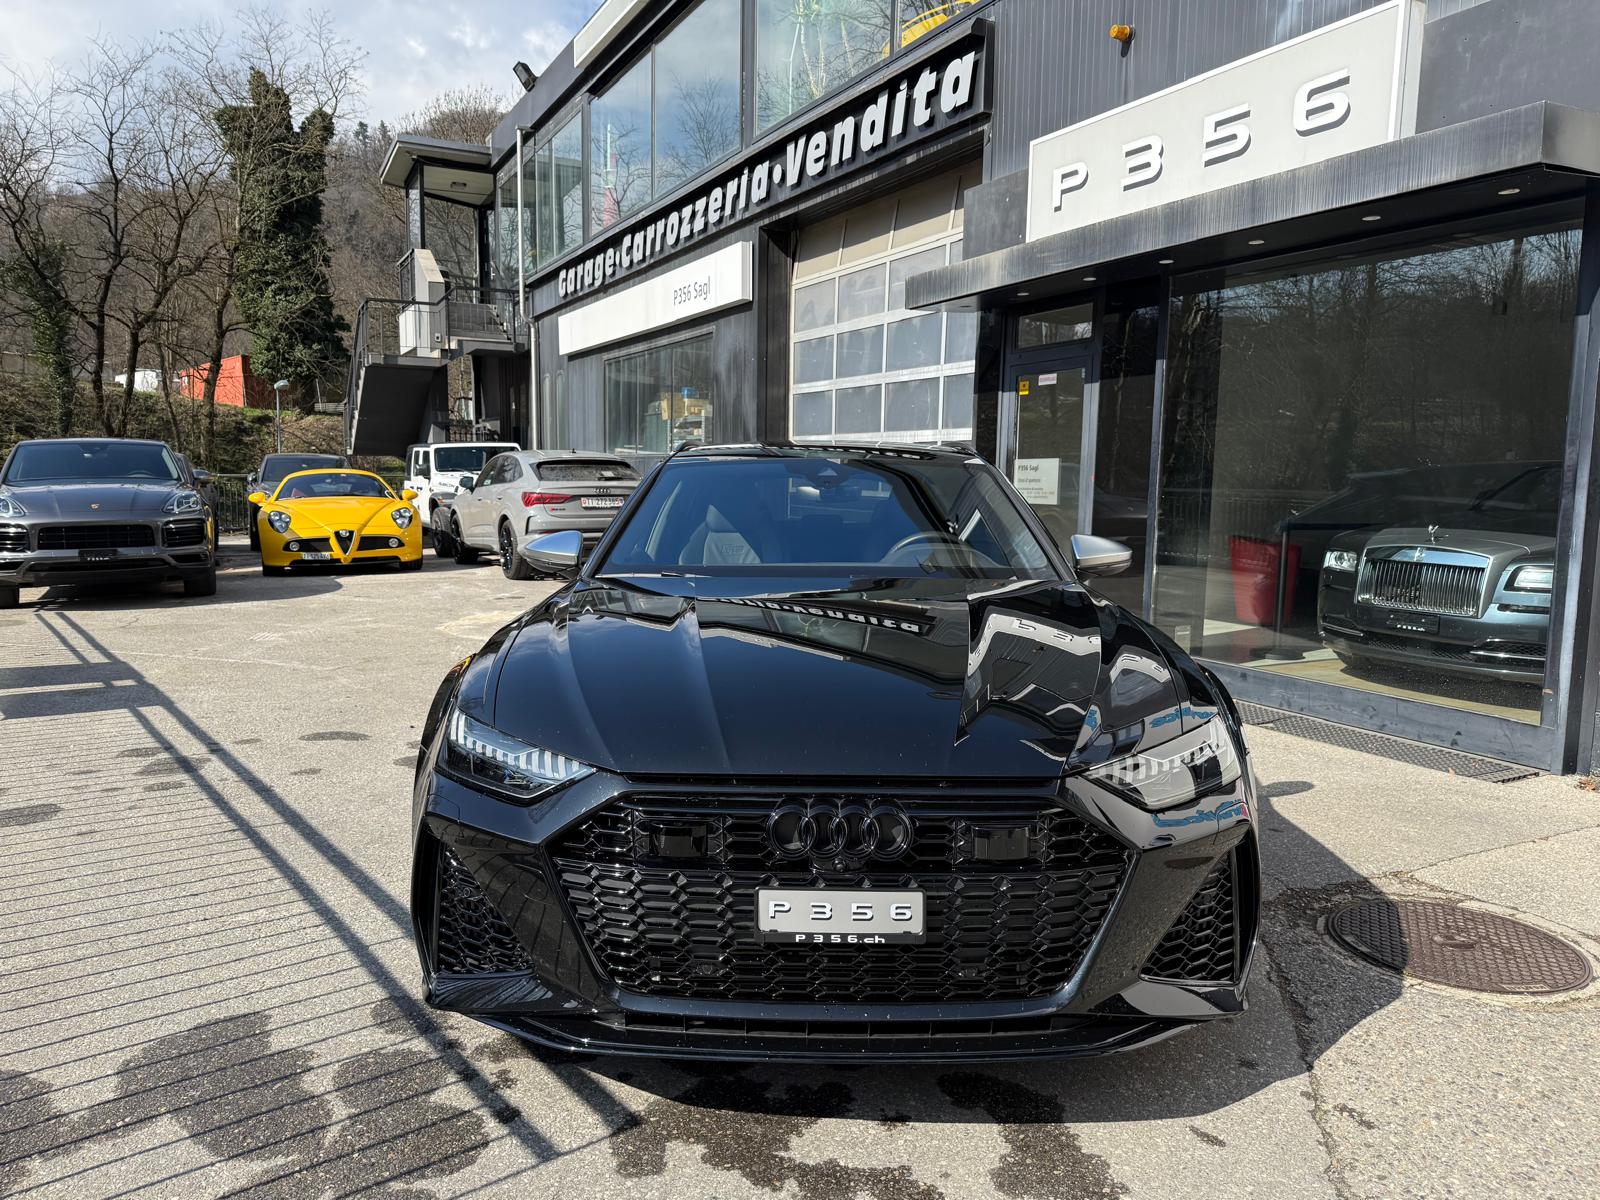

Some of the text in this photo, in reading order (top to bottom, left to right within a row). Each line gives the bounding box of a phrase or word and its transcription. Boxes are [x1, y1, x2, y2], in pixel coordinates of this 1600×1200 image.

[786, 50, 976, 187] Vendita
[673, 275, 711, 306] P356 Sagl
